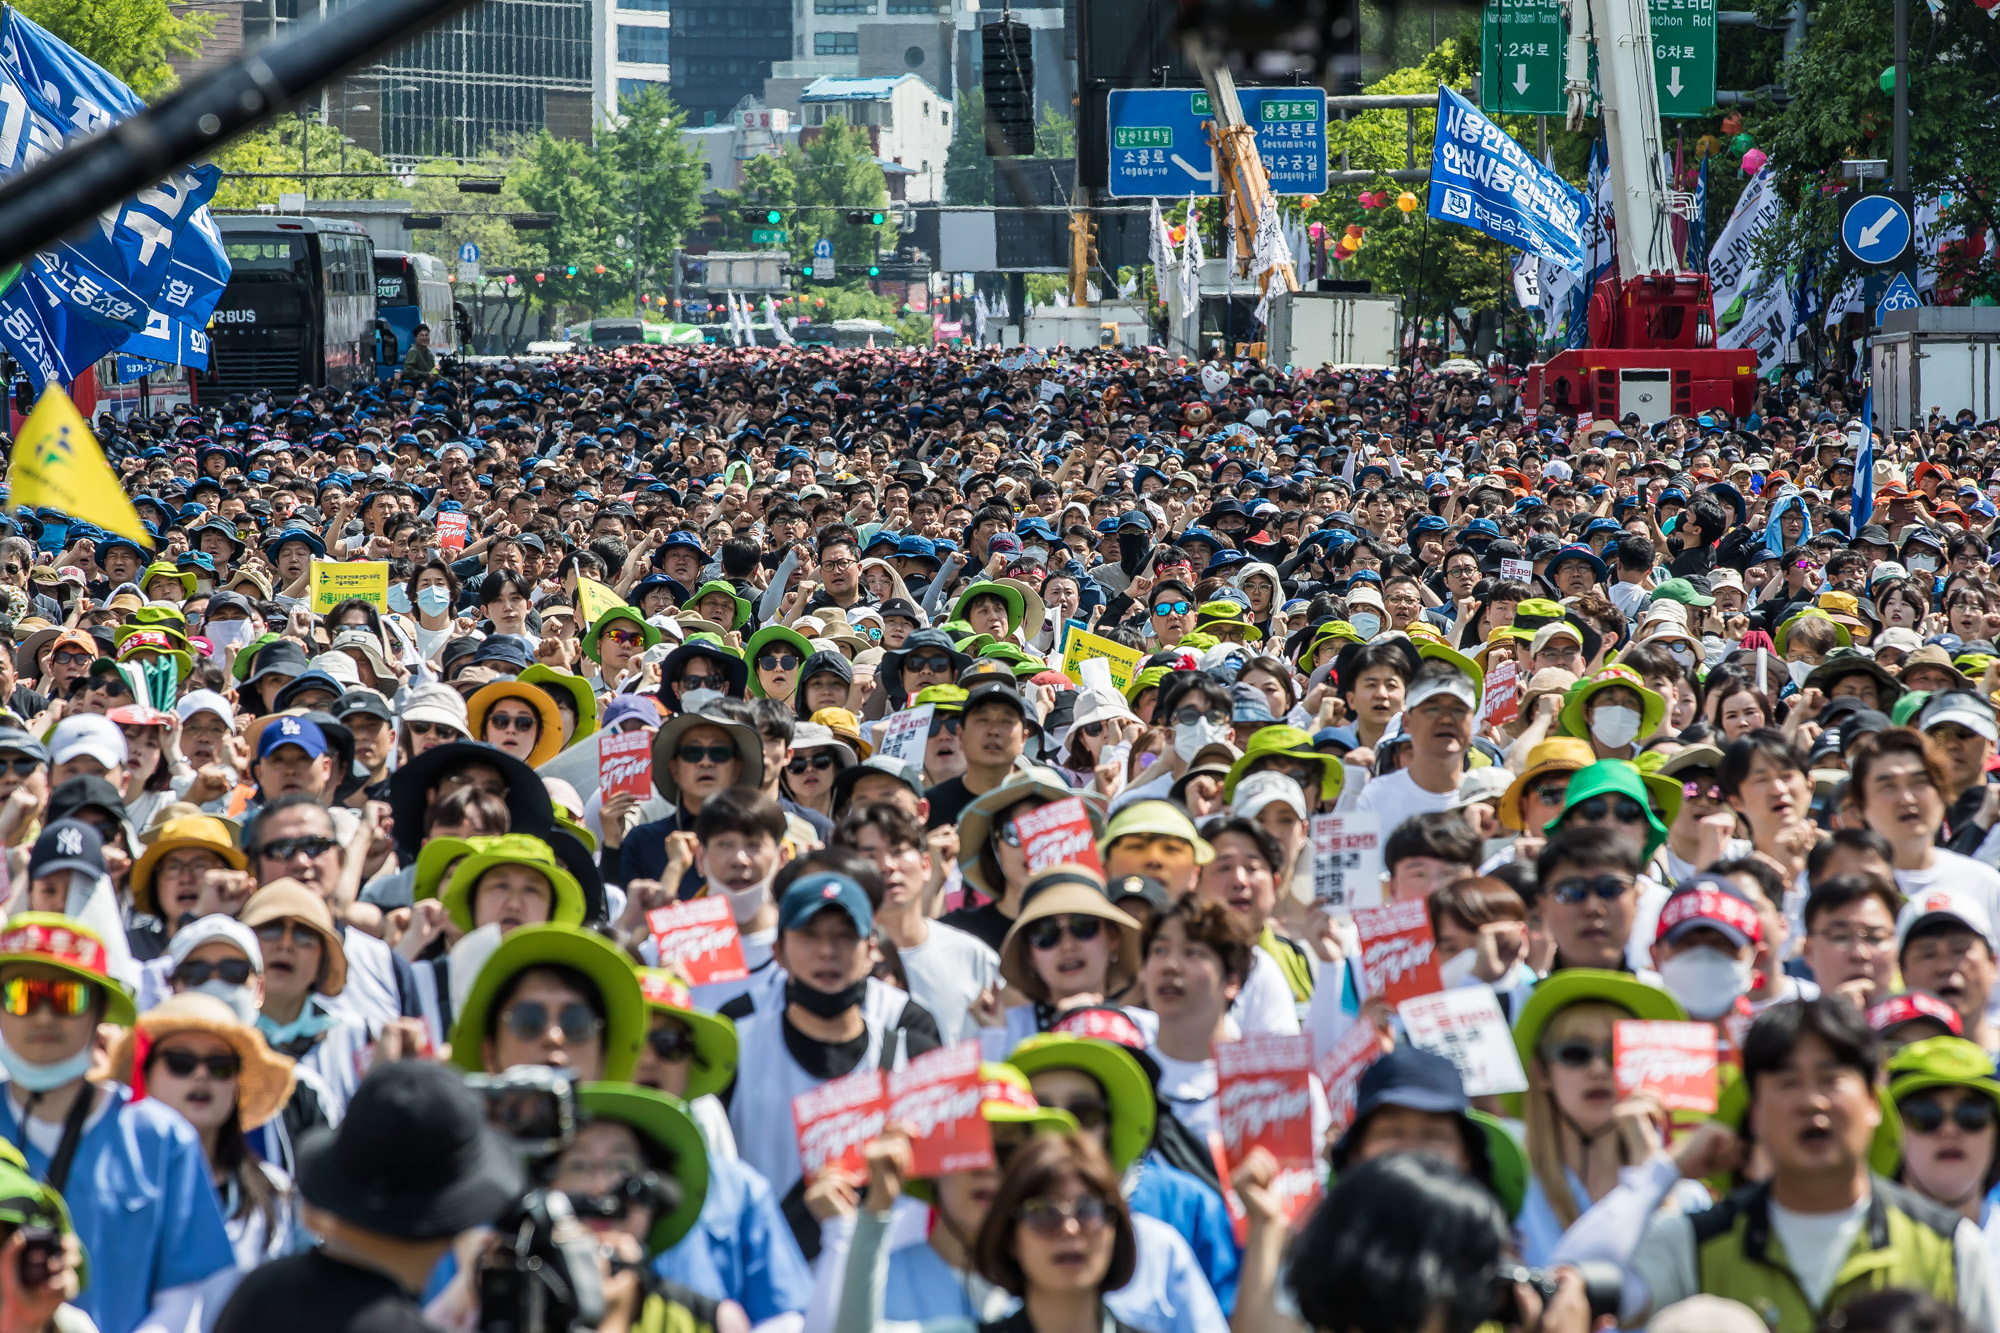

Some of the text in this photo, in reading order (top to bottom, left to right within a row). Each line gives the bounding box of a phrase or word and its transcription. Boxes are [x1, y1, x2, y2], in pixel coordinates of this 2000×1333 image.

[1538, 12, 1558, 23] Tunnel
[1264, 103, 1316, 118] 충정로역
[1262, 124, 1318, 139] 서소문로
[1124, 150, 1165, 164] 소공로
[213, 309, 257, 323] RBUS
